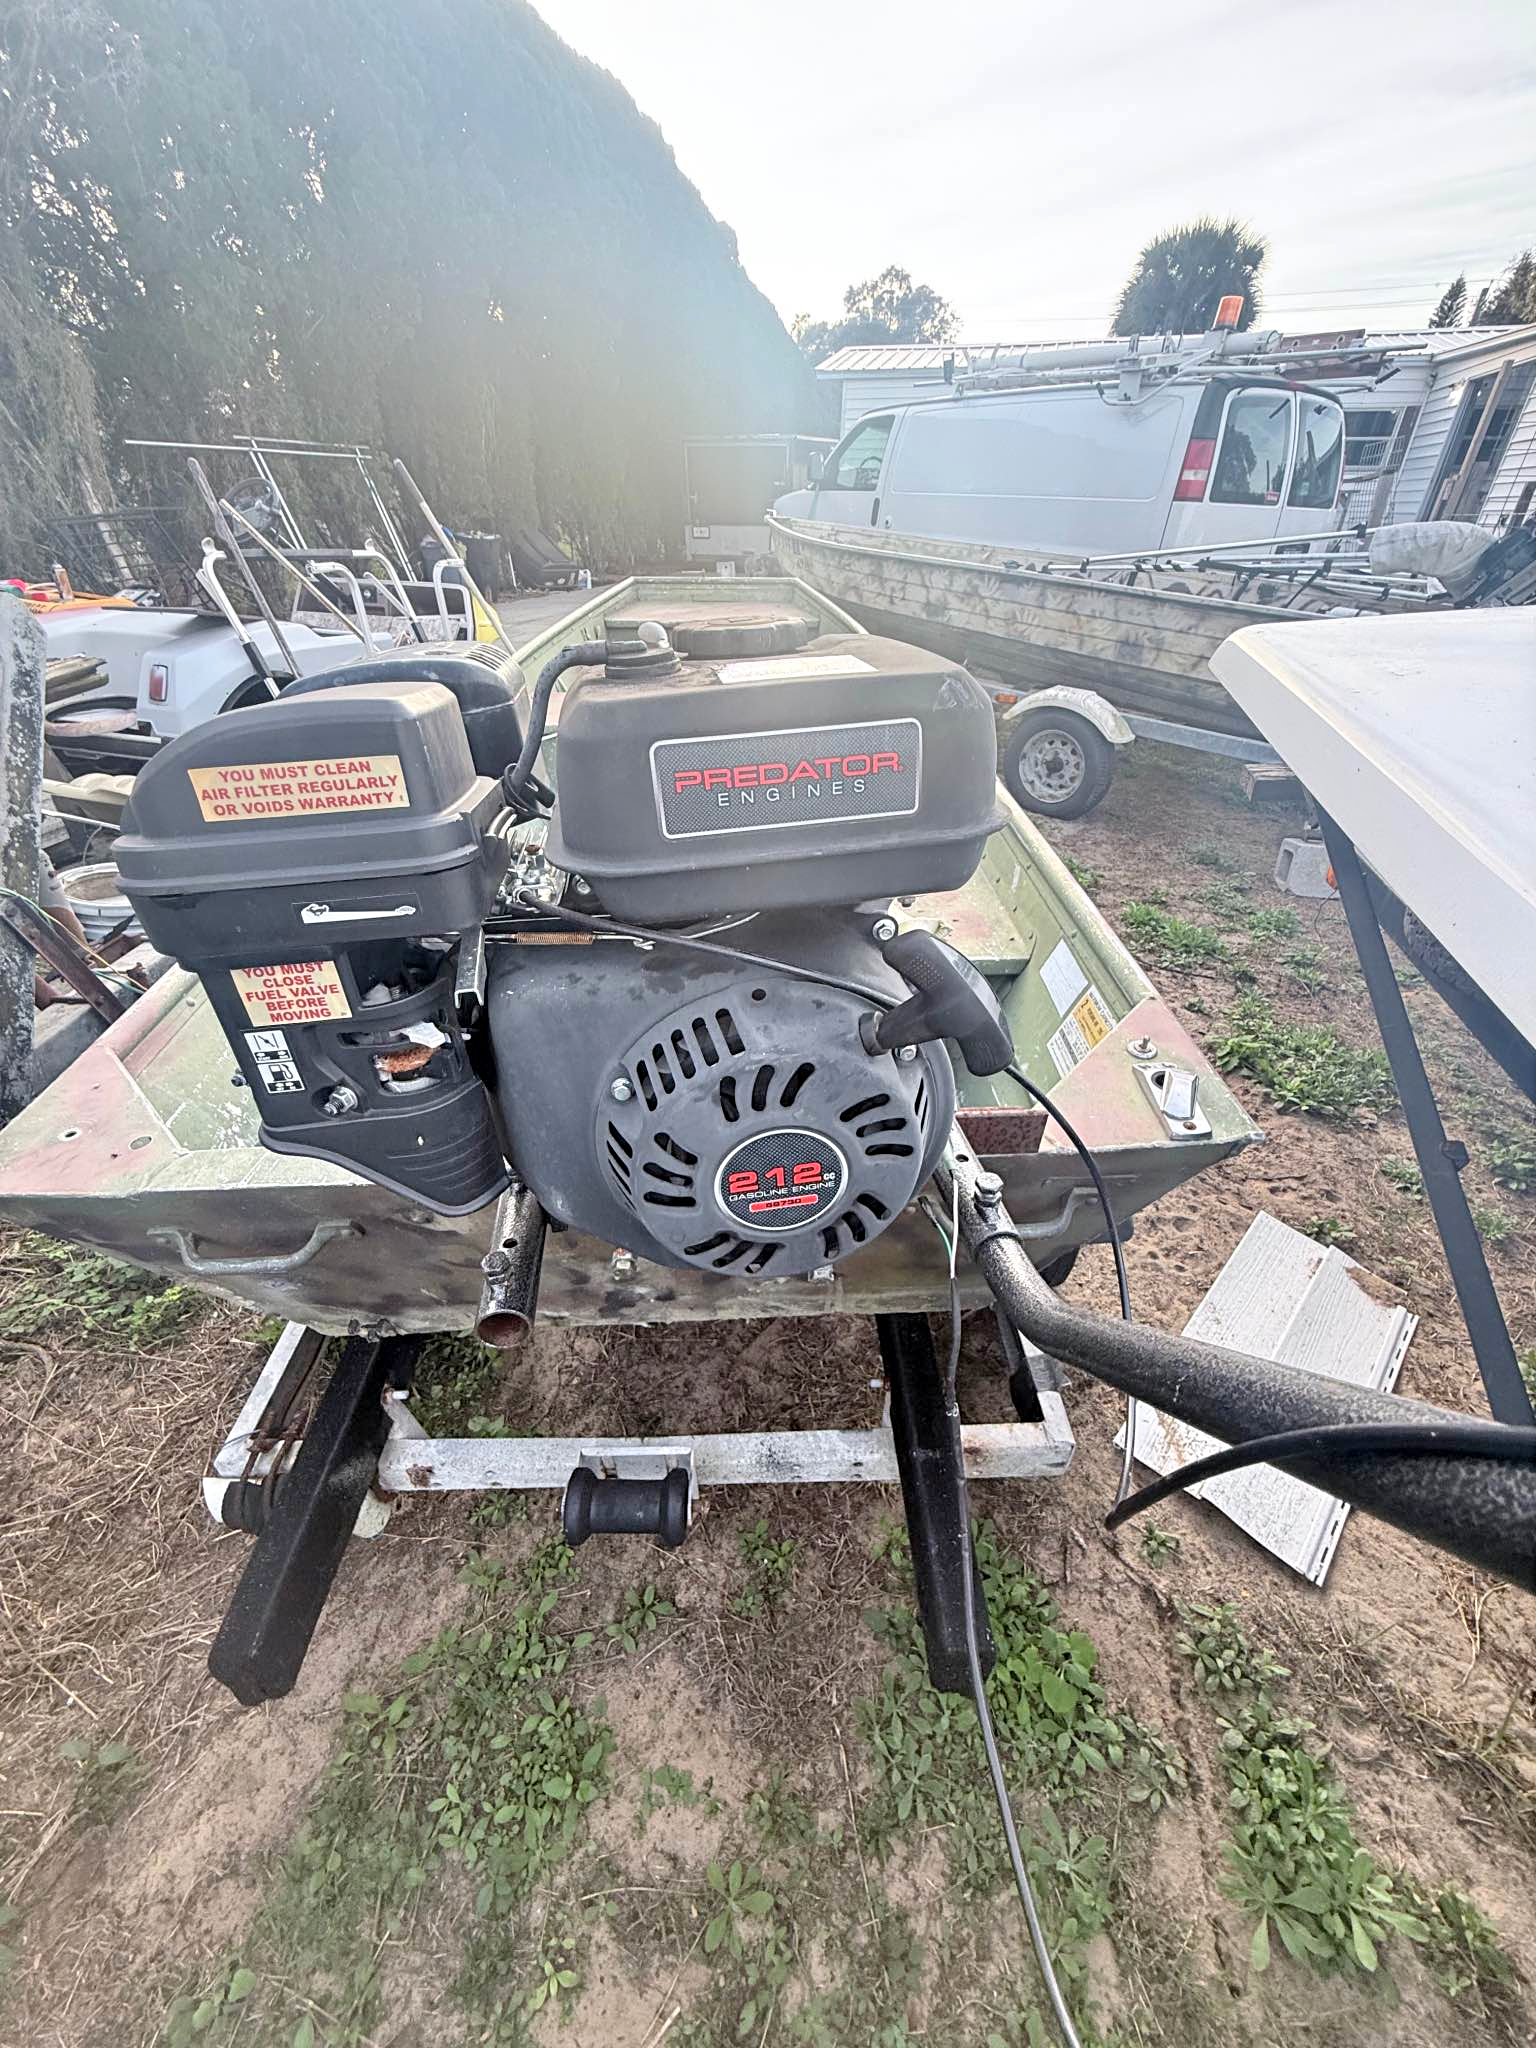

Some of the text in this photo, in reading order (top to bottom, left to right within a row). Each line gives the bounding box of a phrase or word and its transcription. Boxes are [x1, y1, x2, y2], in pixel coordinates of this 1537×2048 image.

[218, 760, 372, 783] YOU MUST CLEAN
[673, 752, 901, 794] PREDATOR
[201, 774, 398, 801] AIR FILTER REGULARLY
[717, 779, 866, 807] ENGINES
[213, 791, 395, 816] OR VOIDS WARRANTY
[242, 961, 324, 979] YOU MUST
[245, 983, 340, 1002] FUEL VALVE
[262, 974, 315, 989] CLOSE
[265, 996, 328, 1012] BEFORE
[269, 1008, 332, 1022] MOVING
[728, 1161, 822, 1194] 212
[729, 1180, 836, 1202] GASOLINE ENGINE
